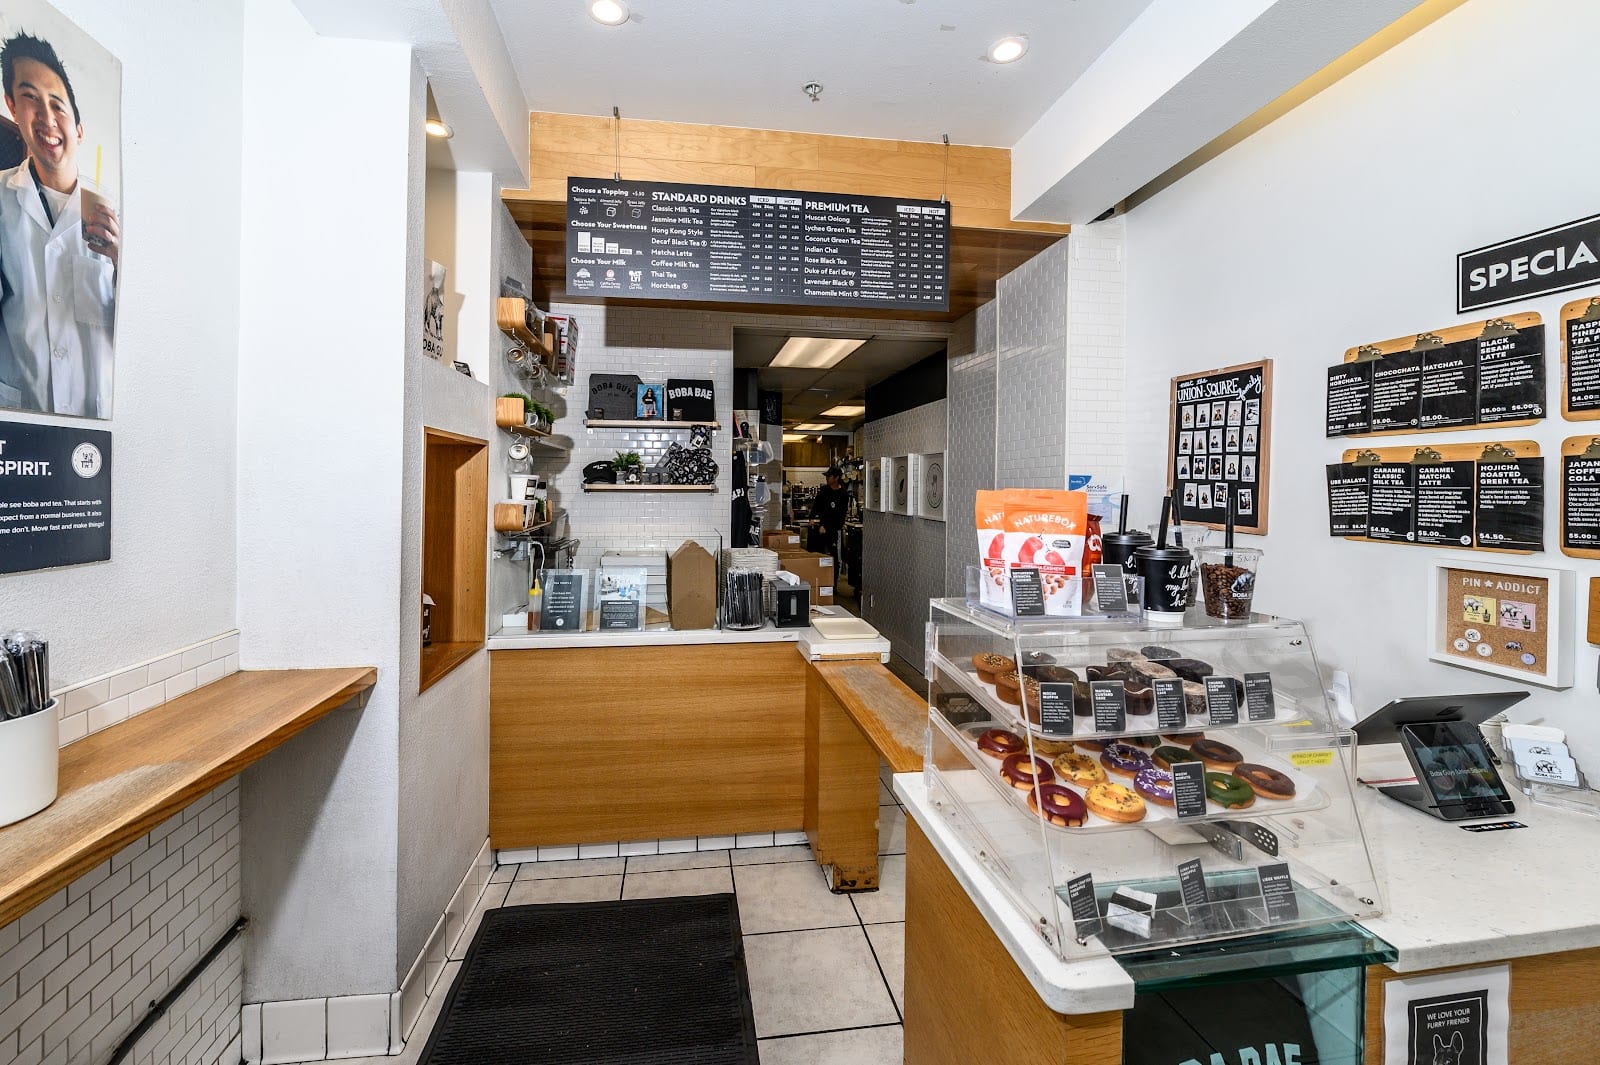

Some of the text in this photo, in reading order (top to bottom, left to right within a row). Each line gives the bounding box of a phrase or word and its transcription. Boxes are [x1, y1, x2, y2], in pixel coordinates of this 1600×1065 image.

[602, 188, 628, 196] Topping
[652, 192, 746, 205] STANDARD DRINKS
[806, 201, 870, 213] PREMIUM TEA
[1469, 241, 1599, 292] SPECIA
[1481, 337, 1509, 347] BLACK
[1571, 336, 1590, 344] TEA
[423, 339, 435, 353] OBA
[1481, 343, 1515, 354] SESAME
[1481, 352, 1506, 361] LATTE
[1423, 360, 1464, 371] MATCHATA
[1375, 366, 1420, 377] CHOCOCHATA
[1330, 377, 1362, 386] HORCHATA
[591, 382, 613, 395] BOBA
[668, 387, 712, 400] BOBA BAE
[1014, 513, 1077, 531] NATUREBOX
[1463, 578, 1541, 594] PIN ADDICT
[1438, 1011, 1452, 1019] LOVE
[1454, 1008, 1471, 1016] YOUR
[1447, 1017, 1470, 1026] FRIENDS
